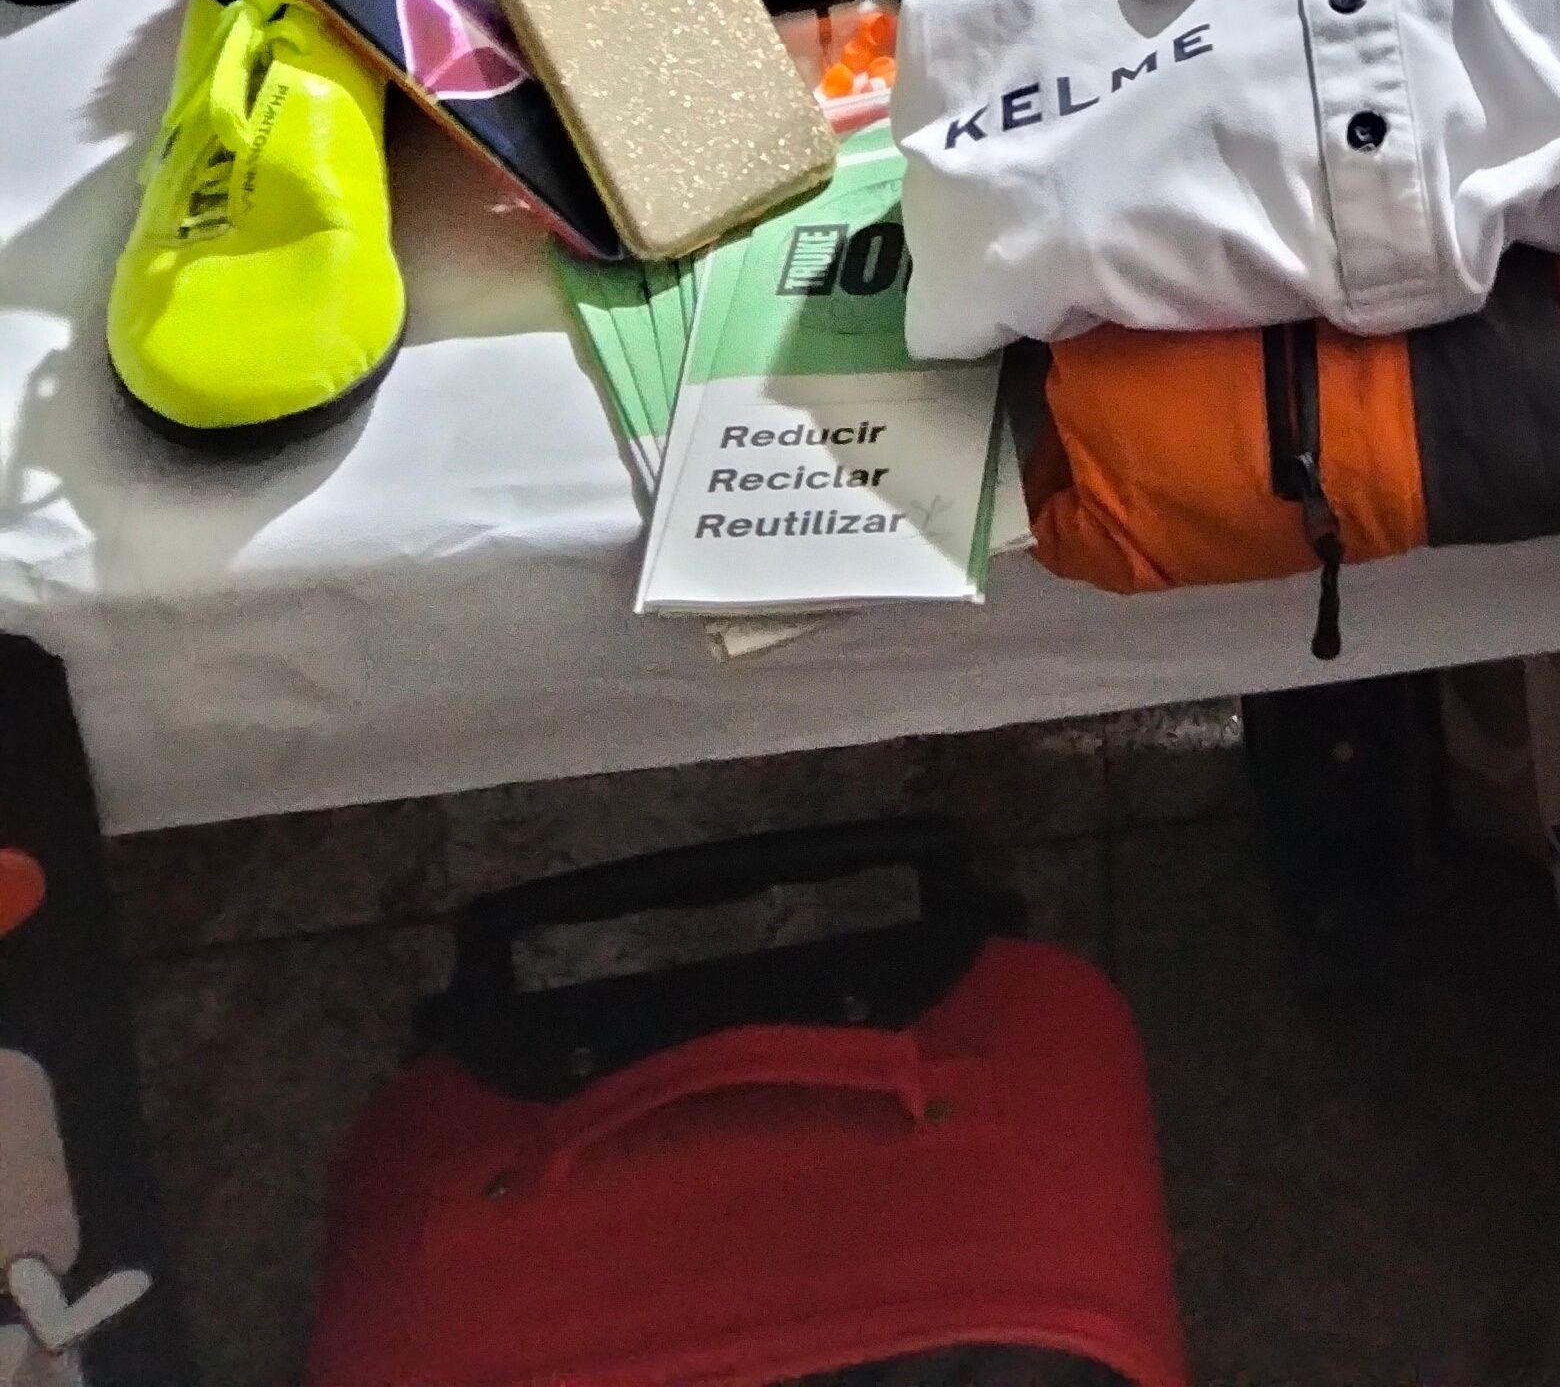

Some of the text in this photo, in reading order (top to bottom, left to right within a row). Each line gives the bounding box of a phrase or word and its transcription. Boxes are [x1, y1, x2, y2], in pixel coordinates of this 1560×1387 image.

[944, 23, 1213, 150] KELME
[784, 222, 913, 295] TRUKE O
[720, 421, 886, 448] Reducir
[708, 465, 889, 493] Reciclar
[695, 510, 907, 539] Reutilizar
